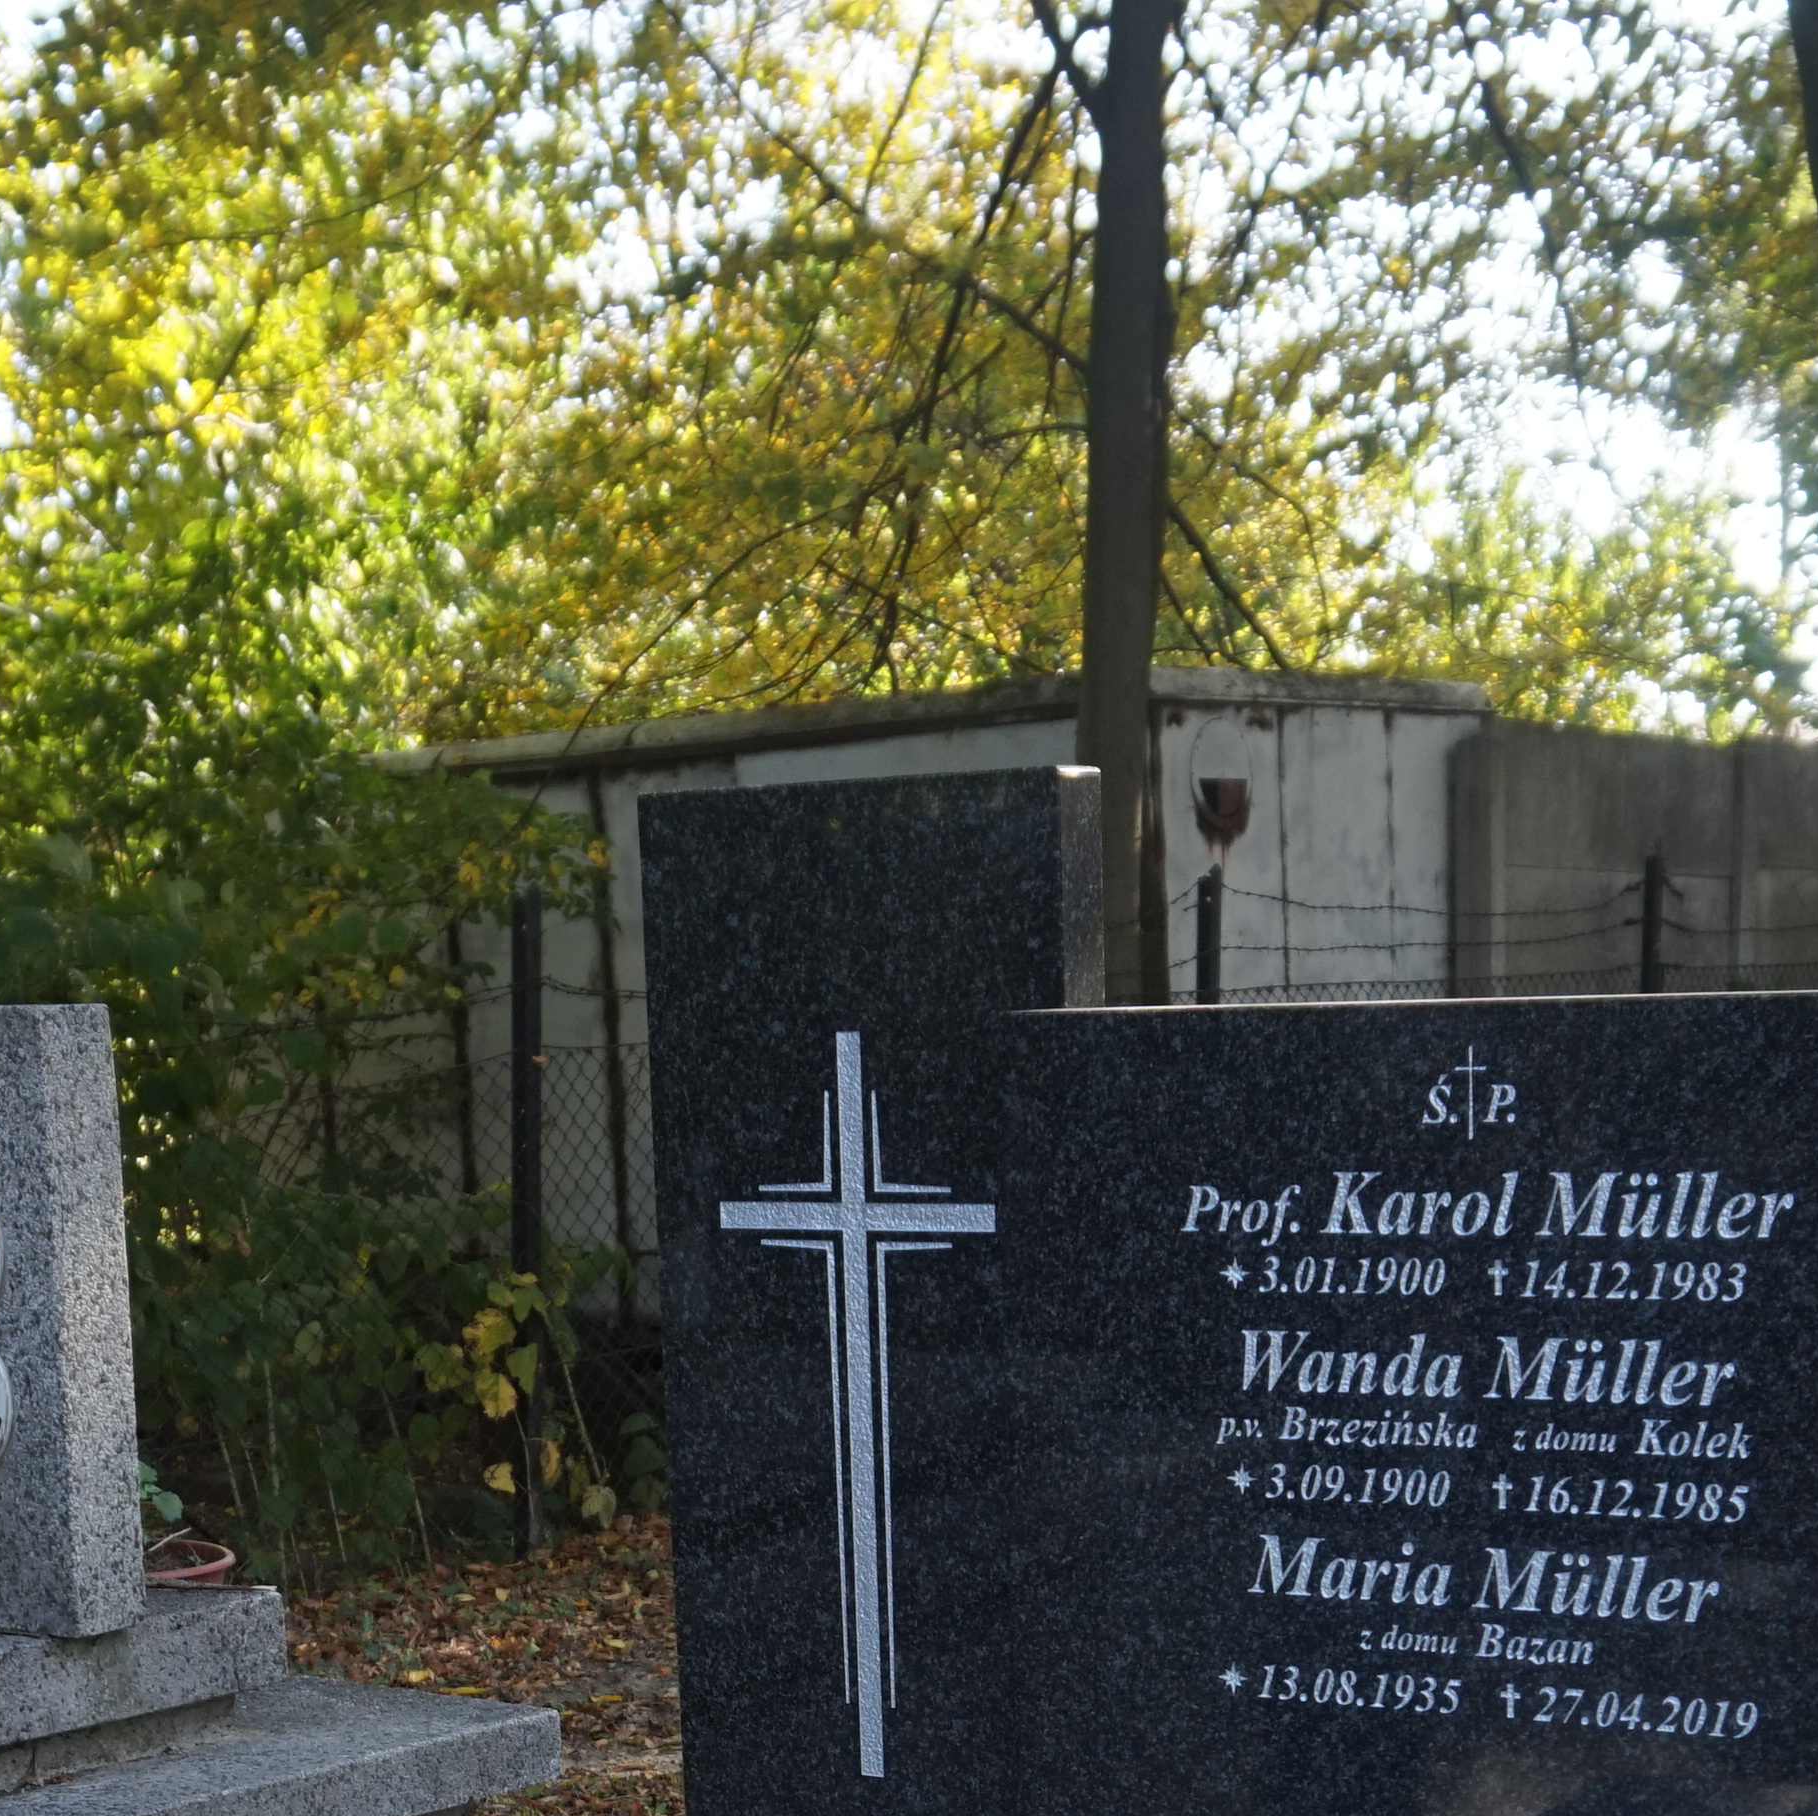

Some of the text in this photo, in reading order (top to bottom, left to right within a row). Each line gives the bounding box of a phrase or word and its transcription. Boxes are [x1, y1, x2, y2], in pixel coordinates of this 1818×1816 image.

[1484, 1084, 1516, 1124] P.
[1182, 1171, 1794, 1247] Prof. Karol Müller
[1258, 1255, 1747, 1303] 3.01.1900 14.12.1983
[1242, 1329, 1736, 1407] Wanda Müller
[1216, 1406, 1749, 1459] p.v. Brzezińska z domu Kolek
[1265, 1463, 1749, 1524] 3.09.1900 16.12.1985
[1248, 1534, 1720, 1623] Maria Müller
[1359, 1623, 1593, 1666] z domu Bazan
[1259, 1665, 1758, 1738] 13.08.1935 27.04.2019
